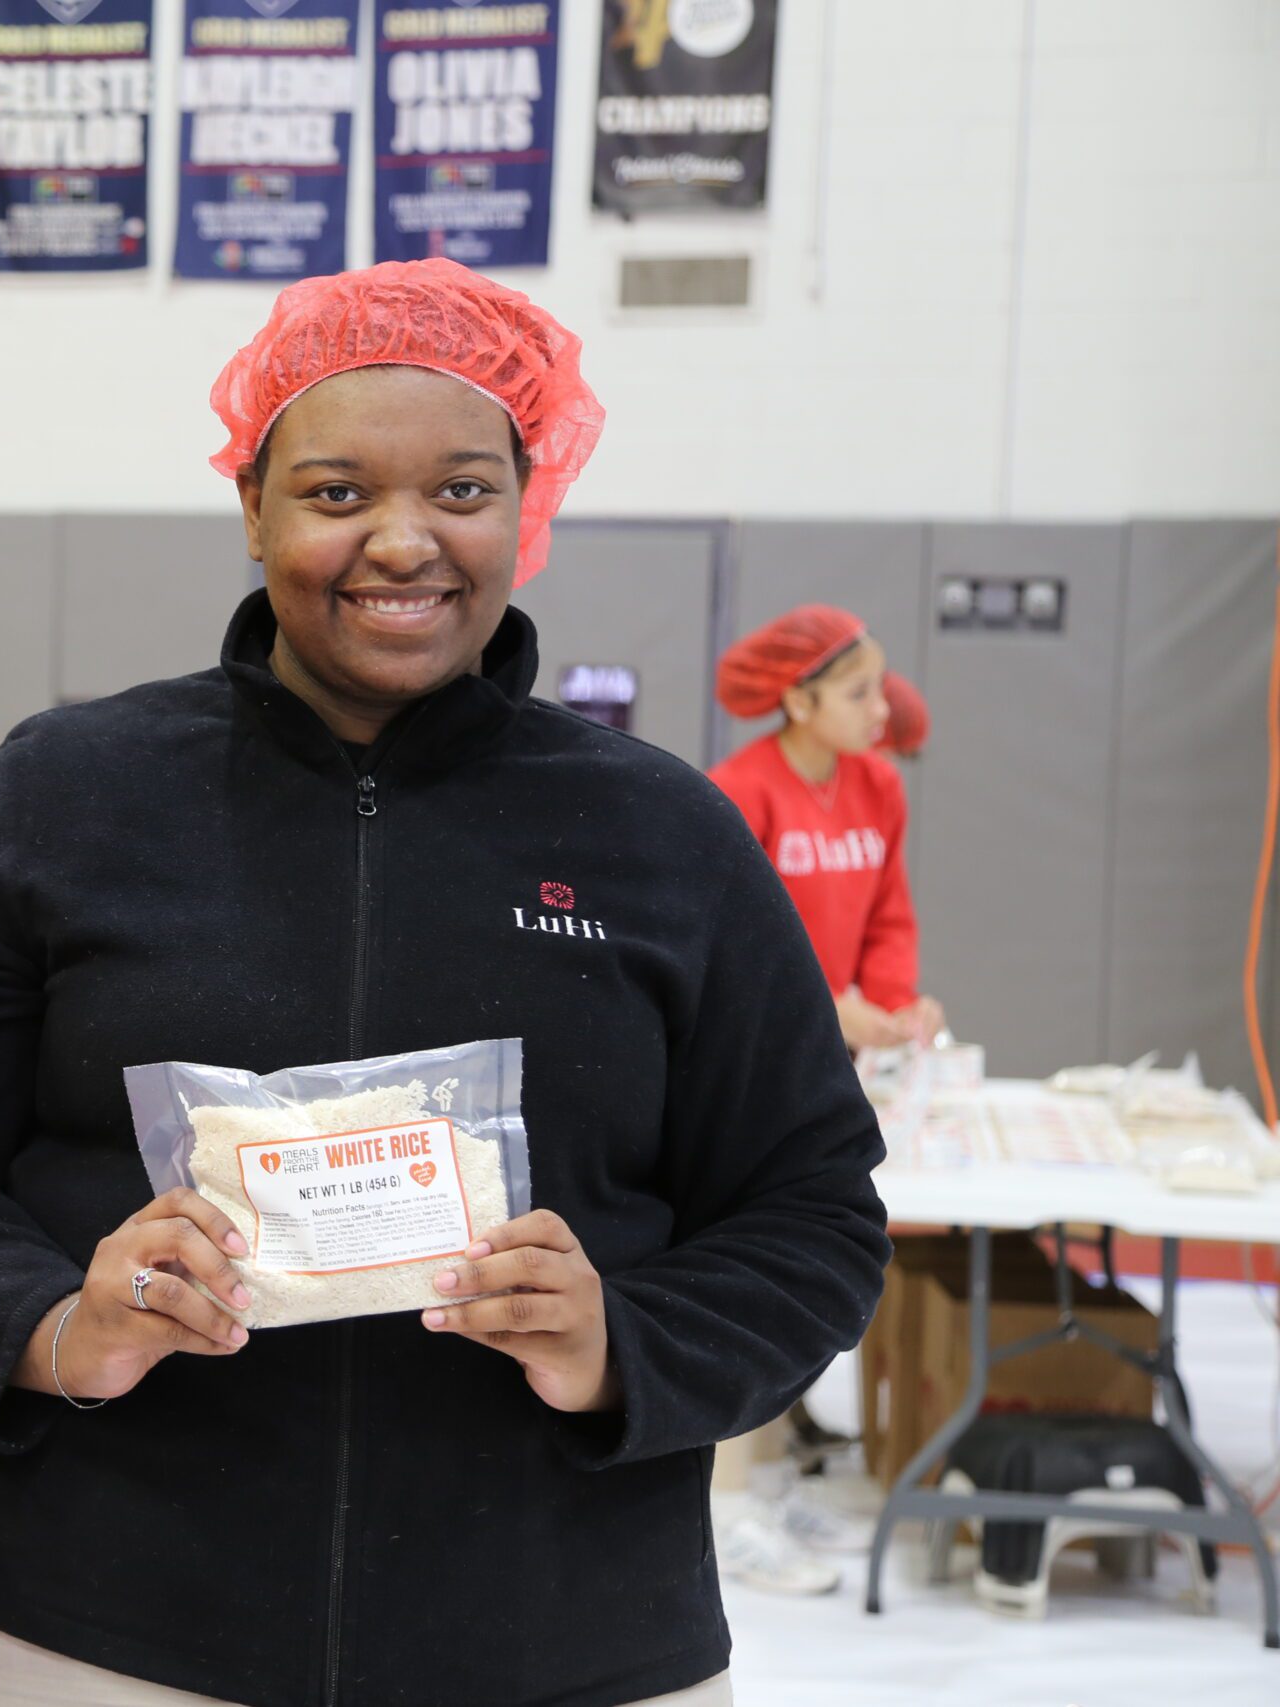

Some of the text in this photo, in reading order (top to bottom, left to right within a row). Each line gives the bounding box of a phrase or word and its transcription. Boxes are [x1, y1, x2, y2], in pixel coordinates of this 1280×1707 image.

[387, 47, 542, 103] OLIVIA
[390, 101, 533, 155] JONES
[597, 94, 770, 135] CHAMPIONS
[512, 907, 606, 940] LuHi
[282, 1147, 319, 1159] MEALS
[324, 1131, 432, 1169] WHITE RICE
[284, 1162, 320, 1174] HEART
[299, 1175, 401, 1200] NET WT 1 LB (454 G)
[312, 1206, 344, 1217] Nutrition
[345, 1204, 366, 1212] Facts
